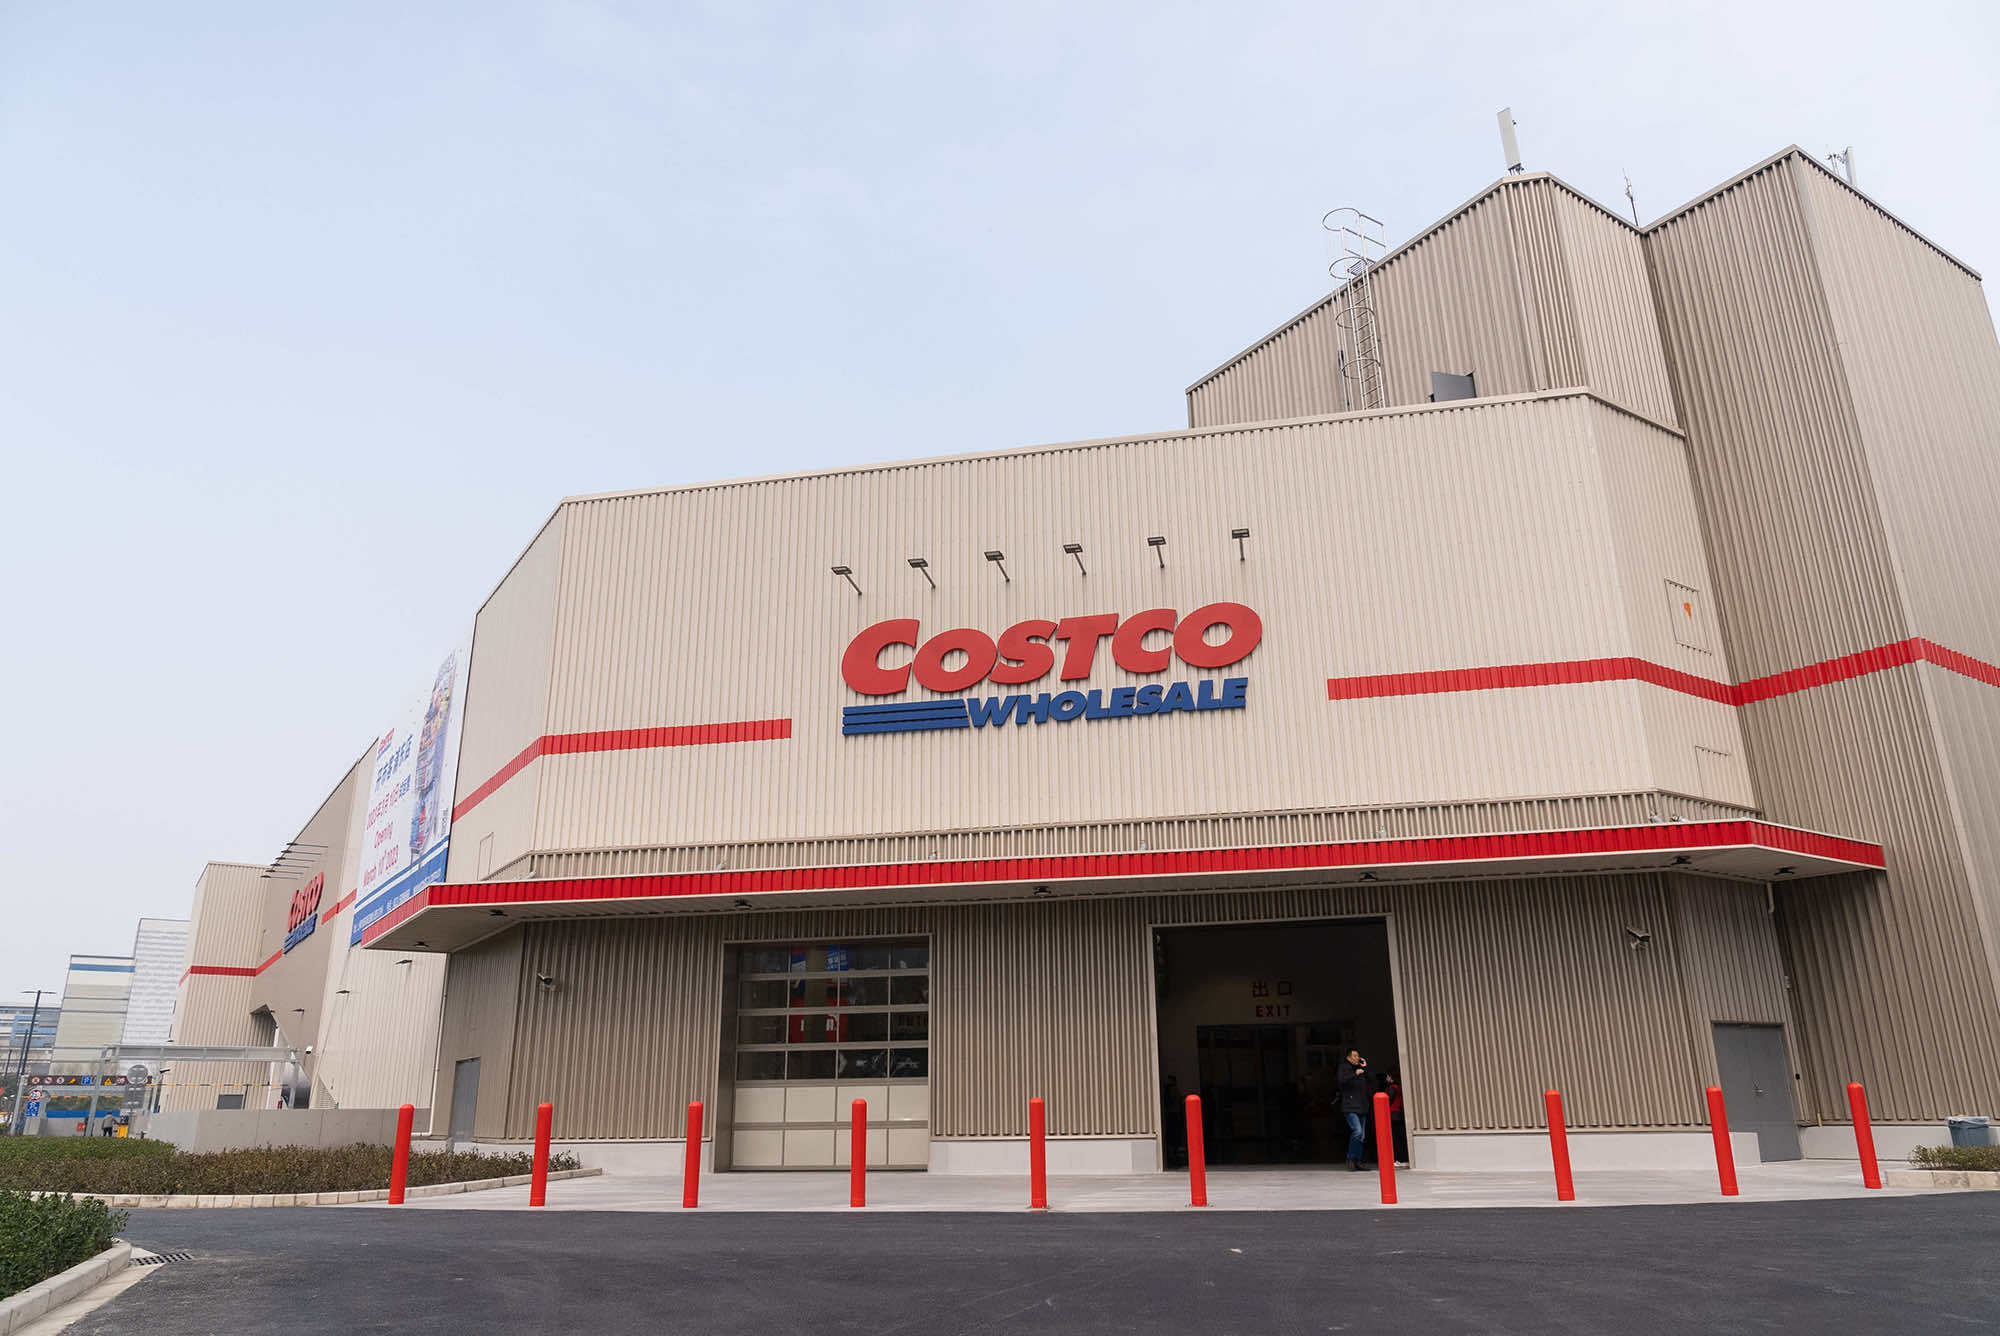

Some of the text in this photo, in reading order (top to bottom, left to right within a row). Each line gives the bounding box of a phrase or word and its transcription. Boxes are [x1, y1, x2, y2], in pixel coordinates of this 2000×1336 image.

[841, 602, 1262, 697] COSTCO
[966, 676, 1249, 728] WHOLESALE
[1252, 982, 1292, 997] 出口
[1255, 1005, 1291, 1017] EXIT
